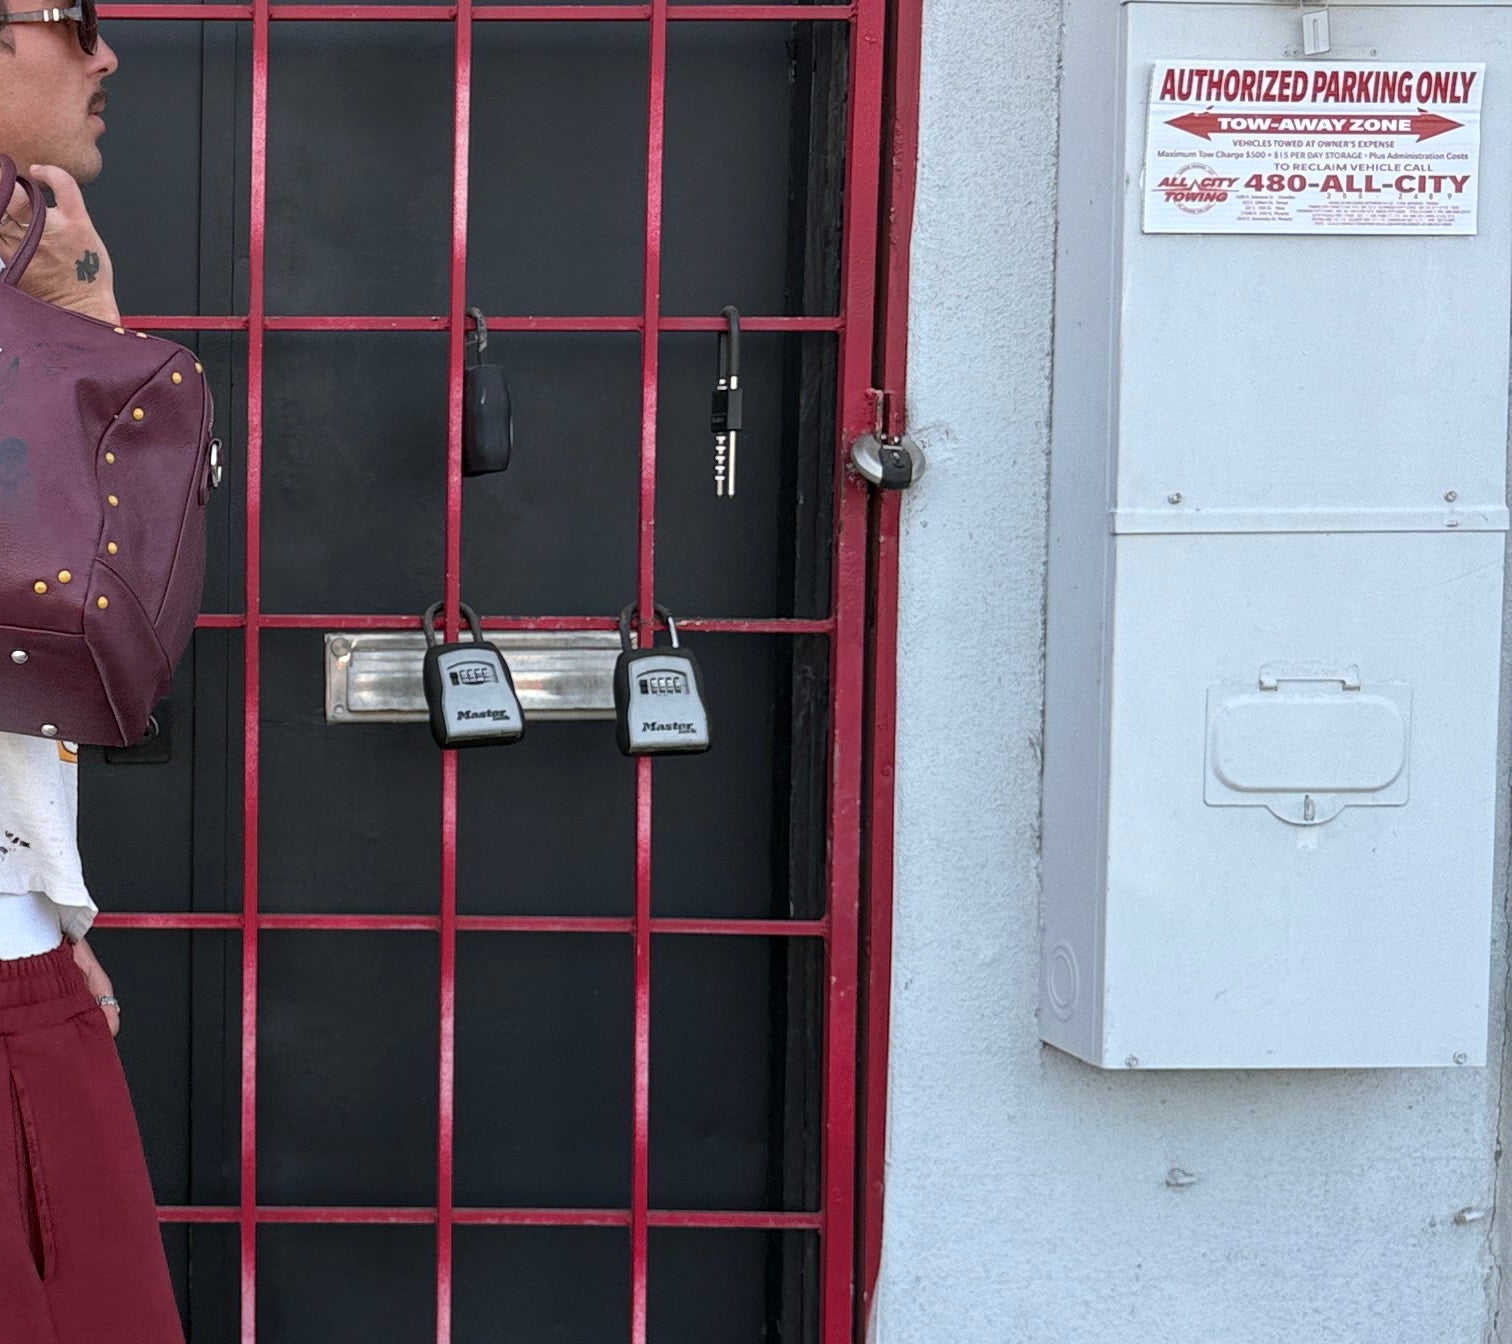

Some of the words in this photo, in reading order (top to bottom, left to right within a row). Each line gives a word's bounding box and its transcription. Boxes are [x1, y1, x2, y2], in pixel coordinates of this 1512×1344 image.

[1159, 68, 1309, 103] AUTHORIZED
[1311, 70, 1414, 104] PARKING
[1416, 71, 1477, 104] ONLY
[1217, 117, 1348, 131] TOW-AWAY
[1349, 119, 1412, 131] ZONE
[1232, 139, 1272, 147] VEHICLES
[1305, 140, 1316, 148] AT
[1317, 140, 1356, 148] OWNER'S
[1216, 151, 1244, 159] Charge
[1290, 151, 1305, 159] PER
[1274, 163, 1290, 171] TO
[1292, 163, 1347, 171] RECLAIM
[1350, 164, 1401, 172] VEHICLE
[1403, 164, 1433, 172] CALL
[1157, 177, 1188, 187] ALL
[1200, 177, 1240, 188] CITY
[1244, 174, 1471, 194] 480-ALL-CITY
[1164, 191, 1229, 202] TOWING
[456, 709, 507, 720] Master
[642, 722, 693, 733] Master
